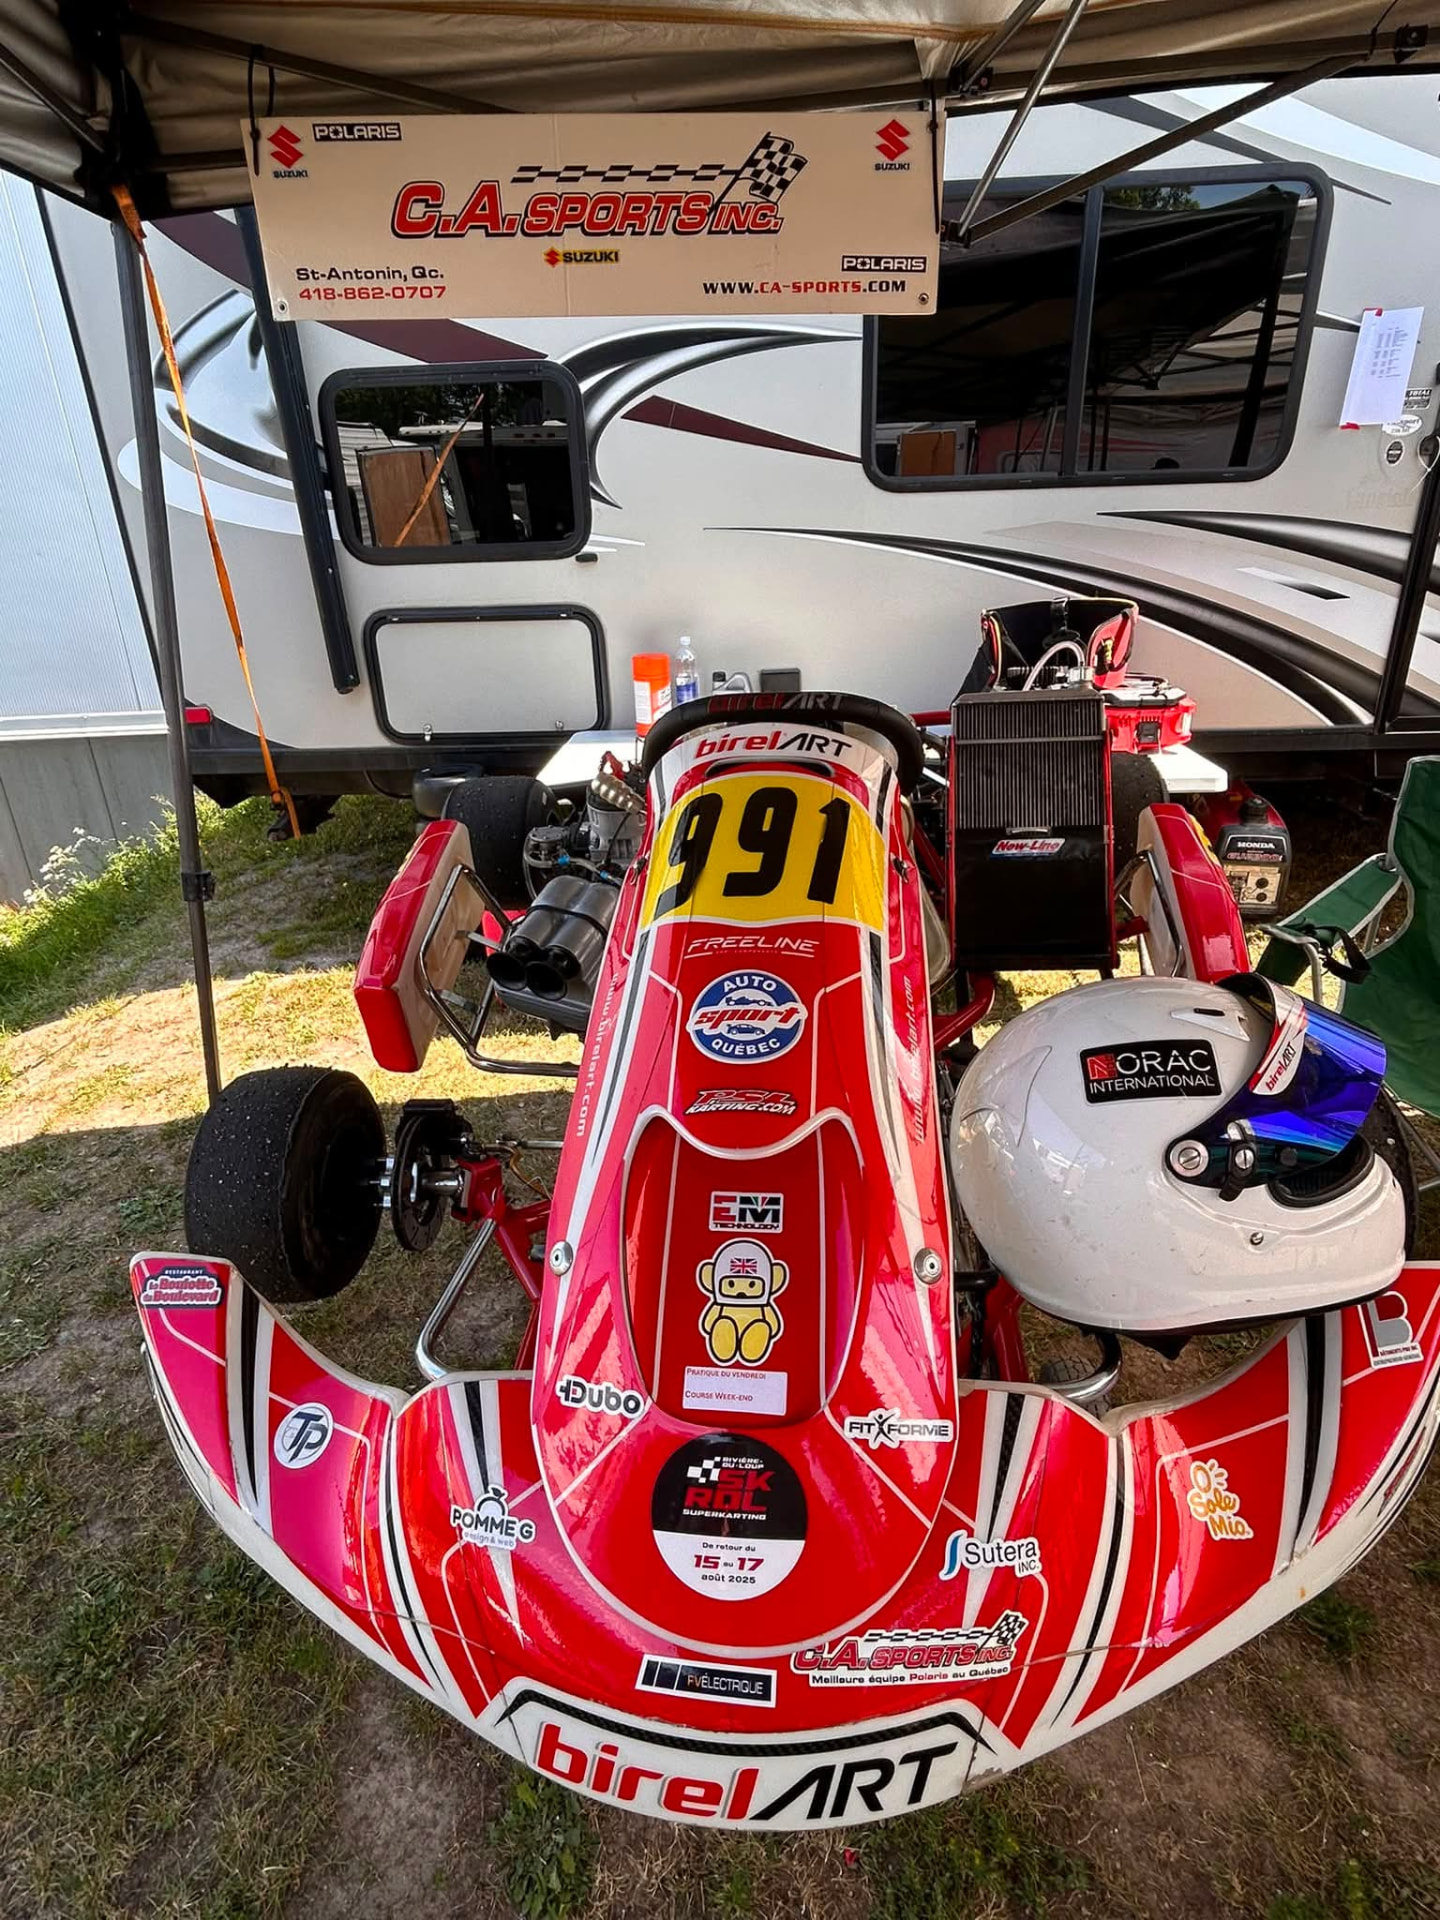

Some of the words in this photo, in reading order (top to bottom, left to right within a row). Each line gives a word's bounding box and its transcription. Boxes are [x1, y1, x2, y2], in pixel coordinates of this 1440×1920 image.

[314, 124, 400, 140] POLARIS
[272, 169, 309, 178] SUZUKI
[875, 162, 910, 171] SUZUKI
[391, 180, 521, 238] C.A.
[523, 191, 713, 237] SPORTS
[708, 200, 785, 236] INC.
[562, 251, 620, 263] SUZUKI
[843, 257, 925, 271] POLARIS
[296, 266, 408, 282] St-Antonin,
[411, 265, 444, 280] Qc.
[299, 285, 447, 301] 418-862-0707
[703, 279, 907, 295] WWW.CA-SPORTS.COM
[694, 730, 853, 759] birelART
[653, 786, 851, 920] 991
[1237, 841, 1276, 849] HONDA
[687, 935, 820, 954] FREELINE
[722, 975, 778, 993] AUTO
[694, 1006, 801, 1030] sport
[576, 972, 620, 1137] www.birelart.com
[711, 1038, 781, 1055] QUÉBEC
[1087, 1049, 1213, 1081] NORAC
[1265, 1041, 1297, 1092] birelART
[1088, 1073, 1216, 1095] INTERNATIONAL
[712, 1195, 782, 1223] EM
[713, 1222, 780, 1230] TECHNOLOGY
[560, 1378, 642, 1415] Dubo
[719, 1469, 776, 1492] SK
[1189, 1487, 1237, 1518] Sole
[452, 1507, 517, 1538] POMME
[519, 1522, 534, 1540] G
[682, 1508, 767, 1521] SUPERKARTING
[1208, 1514, 1246, 1537] Mio
[702, 1541, 714, 1550] De
[715, 1543, 742, 1551] retour
[744, 1543, 757, 1552] du
[964, 1540, 1037, 1566] Sutera
[693, 1554, 721, 1569] 15
[737, 1557, 765, 1571] 17
[1018, 1560, 1040, 1574] INC.
[701, 1573, 725, 1582] août
[728, 1574, 757, 1584] 2025
[868, 1644, 979, 1670] SPORTS
[975, 1645, 1014, 1663] INC.
[812, 1674, 865, 1684] Meilleure
[868, 1673, 906, 1685] équipe
[909, 1672, 948, 1682] Polaris
[952, 1671, 966, 1679] au
[969, 1665, 1009, 1678] Québec
[535, 1720, 960, 1822] birelART
